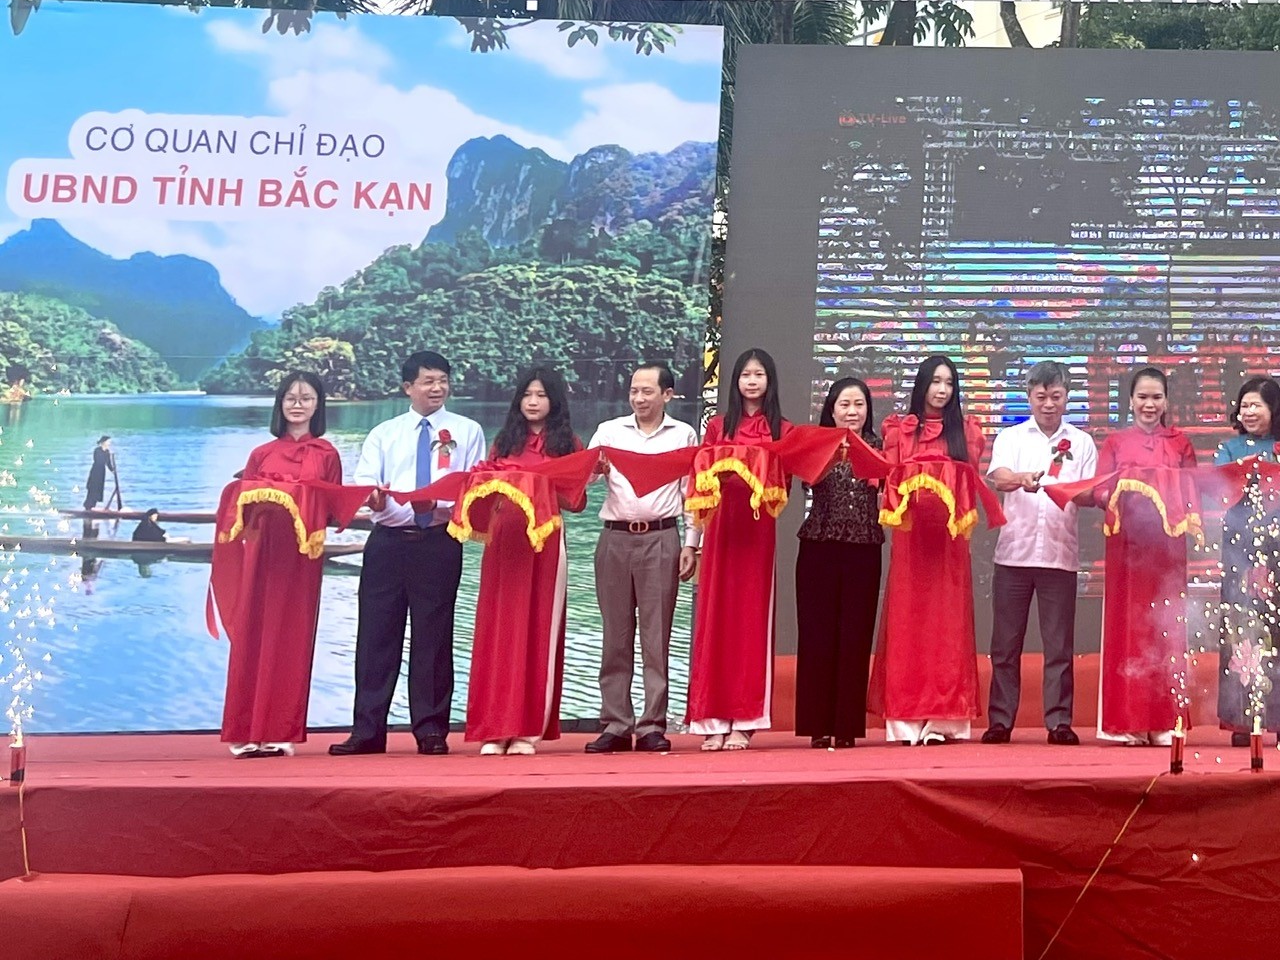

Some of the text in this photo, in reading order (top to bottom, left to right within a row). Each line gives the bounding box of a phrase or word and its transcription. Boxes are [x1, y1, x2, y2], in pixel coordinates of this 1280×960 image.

[85, 123, 386, 162] CƠ QUAN CHỈ ĐẠO
[22, 164, 433, 217] UBND TỈNH BẮC KẠN
